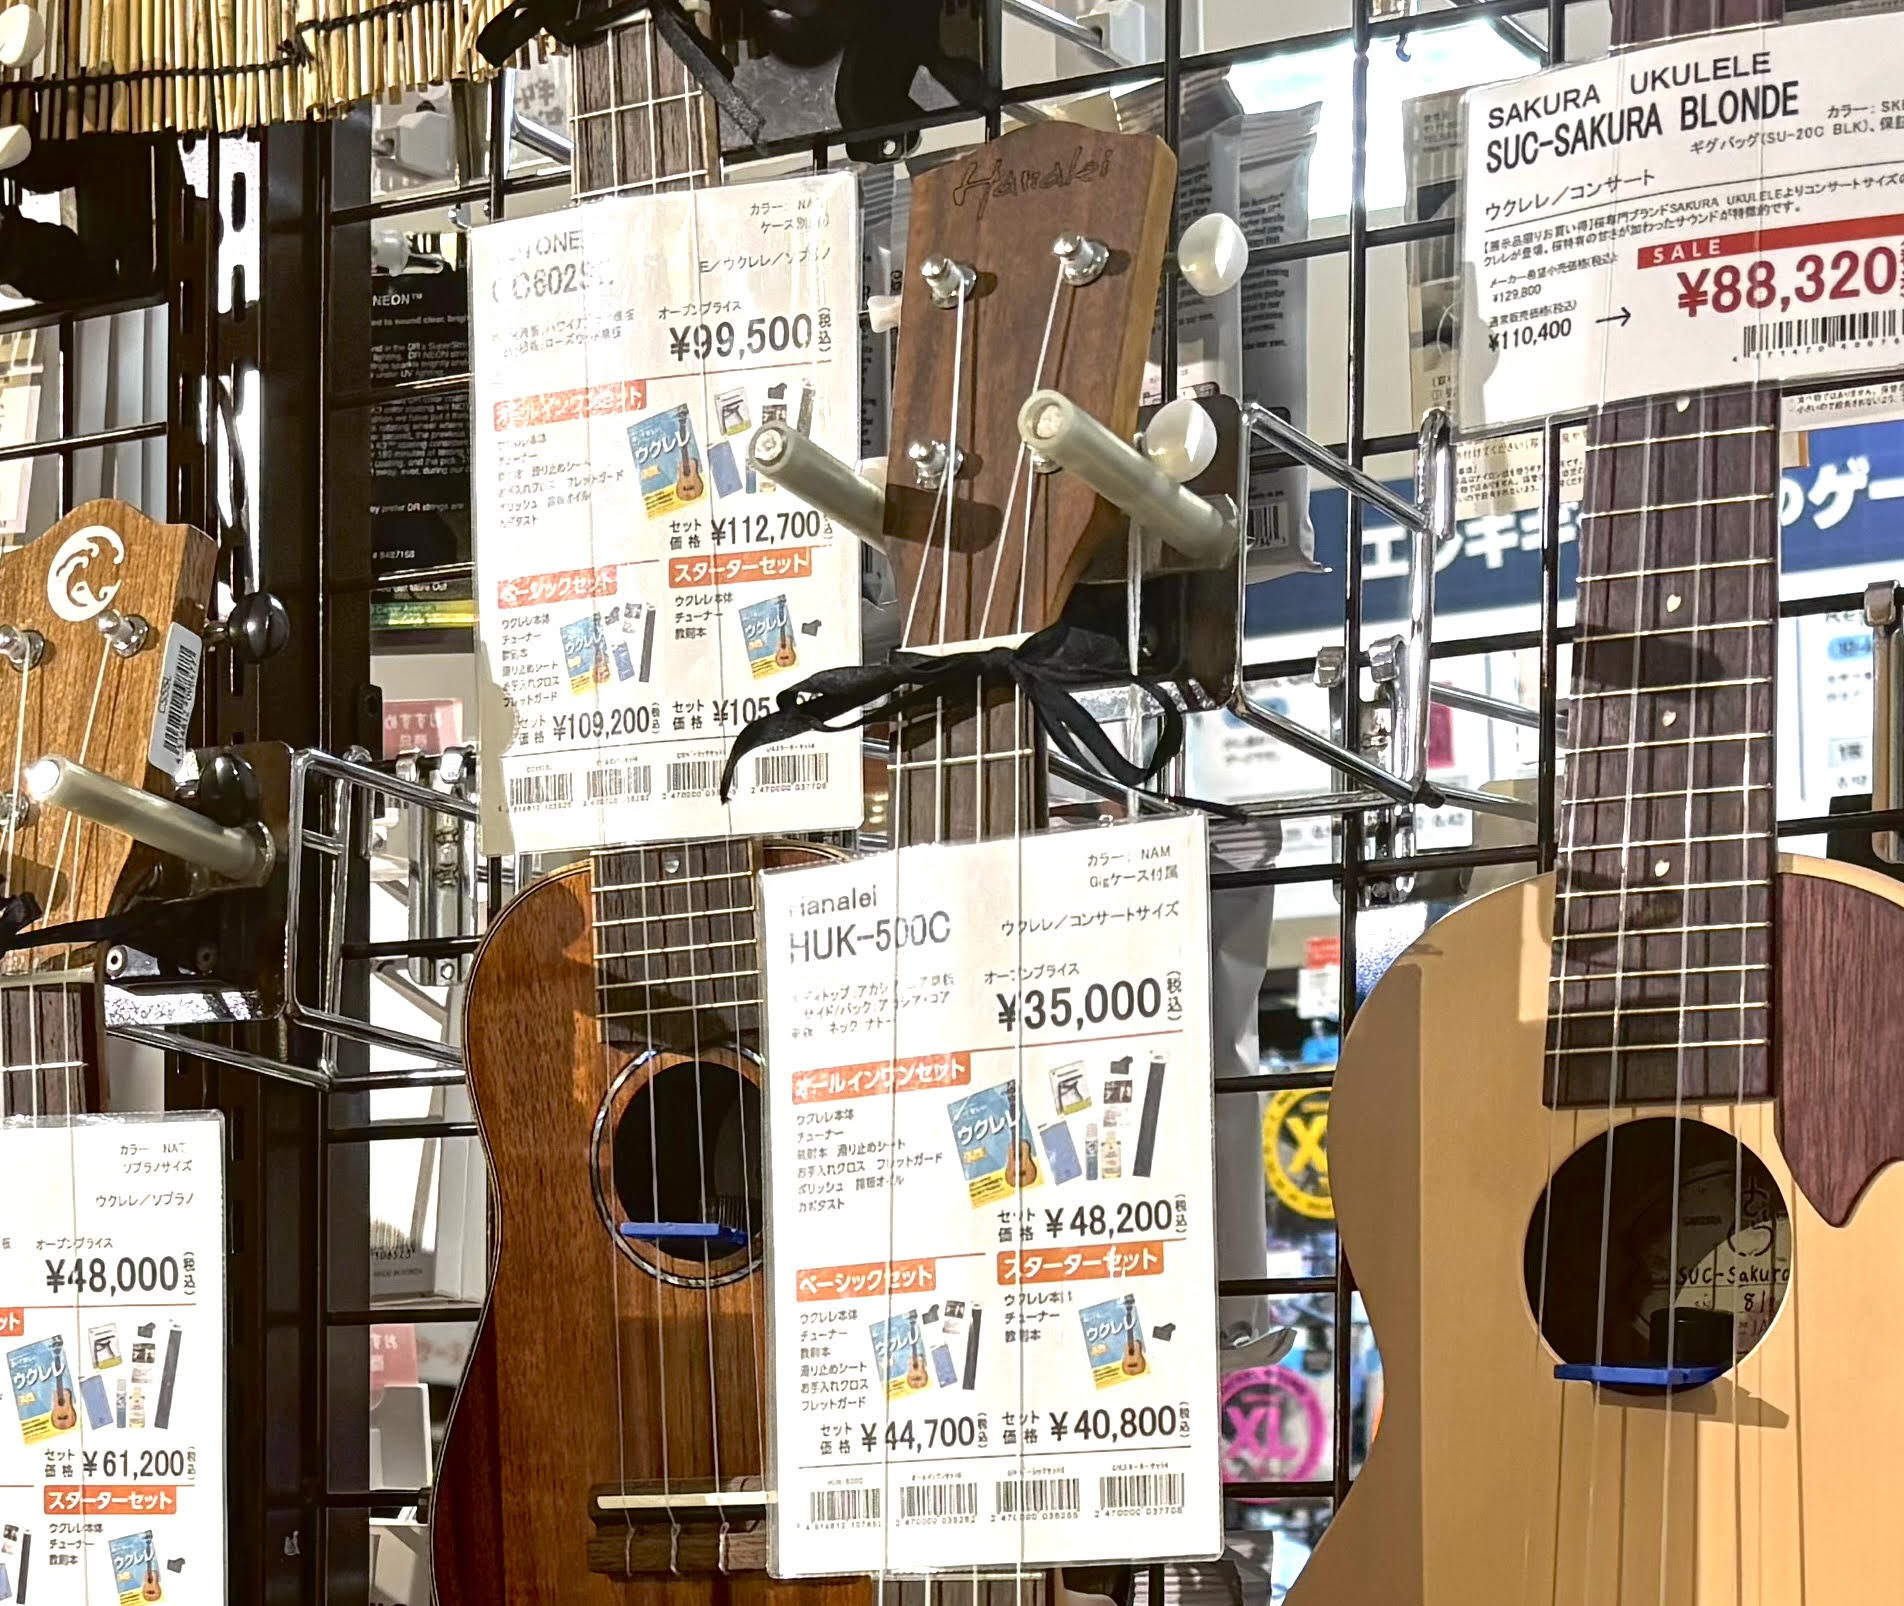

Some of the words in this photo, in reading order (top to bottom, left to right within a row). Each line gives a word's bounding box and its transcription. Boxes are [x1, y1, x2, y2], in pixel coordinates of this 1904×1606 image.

[1487, 84, 1601, 129] SAKURA
[1630, 52, 1772, 94] UKULELE
[1486, 109, 1662, 173] SUC-SAKURA
[1681, 80, 1799, 130] BLONDE
[953, 145, 1113, 222] Hanalei
[1485, 170, 1656, 220] ウクレレ／コンサート
[1652, 238, 1722, 264] SALE
[1677, 246, 1898, 317] ¥88,320
[670, 314, 814, 361] ¥99,500
[1488, 319, 1572, 352] ¥110,400
[710, 509, 821, 546] ¥112,700
[674, 553, 809, 585] スターターセット
[553, 704, 651, 739] ¥109,200
[1140, 845, 1172, 861] NAM
[789, 910, 952, 964] HUK-500C
[1000, 900, 1180, 937] ウクレレ／コンサートサイズ
[996, 977, 1162, 1032] ¥35,000
[1167, 968, 1183, 1022] (税込)
[795, 1056, 966, 1099] オールインワンセット
[957, 1104, 1018, 1146] ウクレレ
[1044, 1199, 1173, 1239] ¥48,200
[45, 1255, 179, 1294] ¥48,000
[798, 1264, 934, 1296] ベーシックセット
[1002, 1249, 1159, 1280] スターターセット
[800, 1309, 858, 1325] ウクレレ本体
[800, 1328, 848, 1342] チューナー
[11, 1359, 66, 1391] ウクレレ
[860, 1416, 975, 1454] ¥44,700
[1049, 1405, 1177, 1442] ¥40,800
[82, 1448, 185, 1480] ¥61,200
[49, 1489, 173, 1512] スターターセット
[49, 1521, 104, 1536] ウクレレ本体
